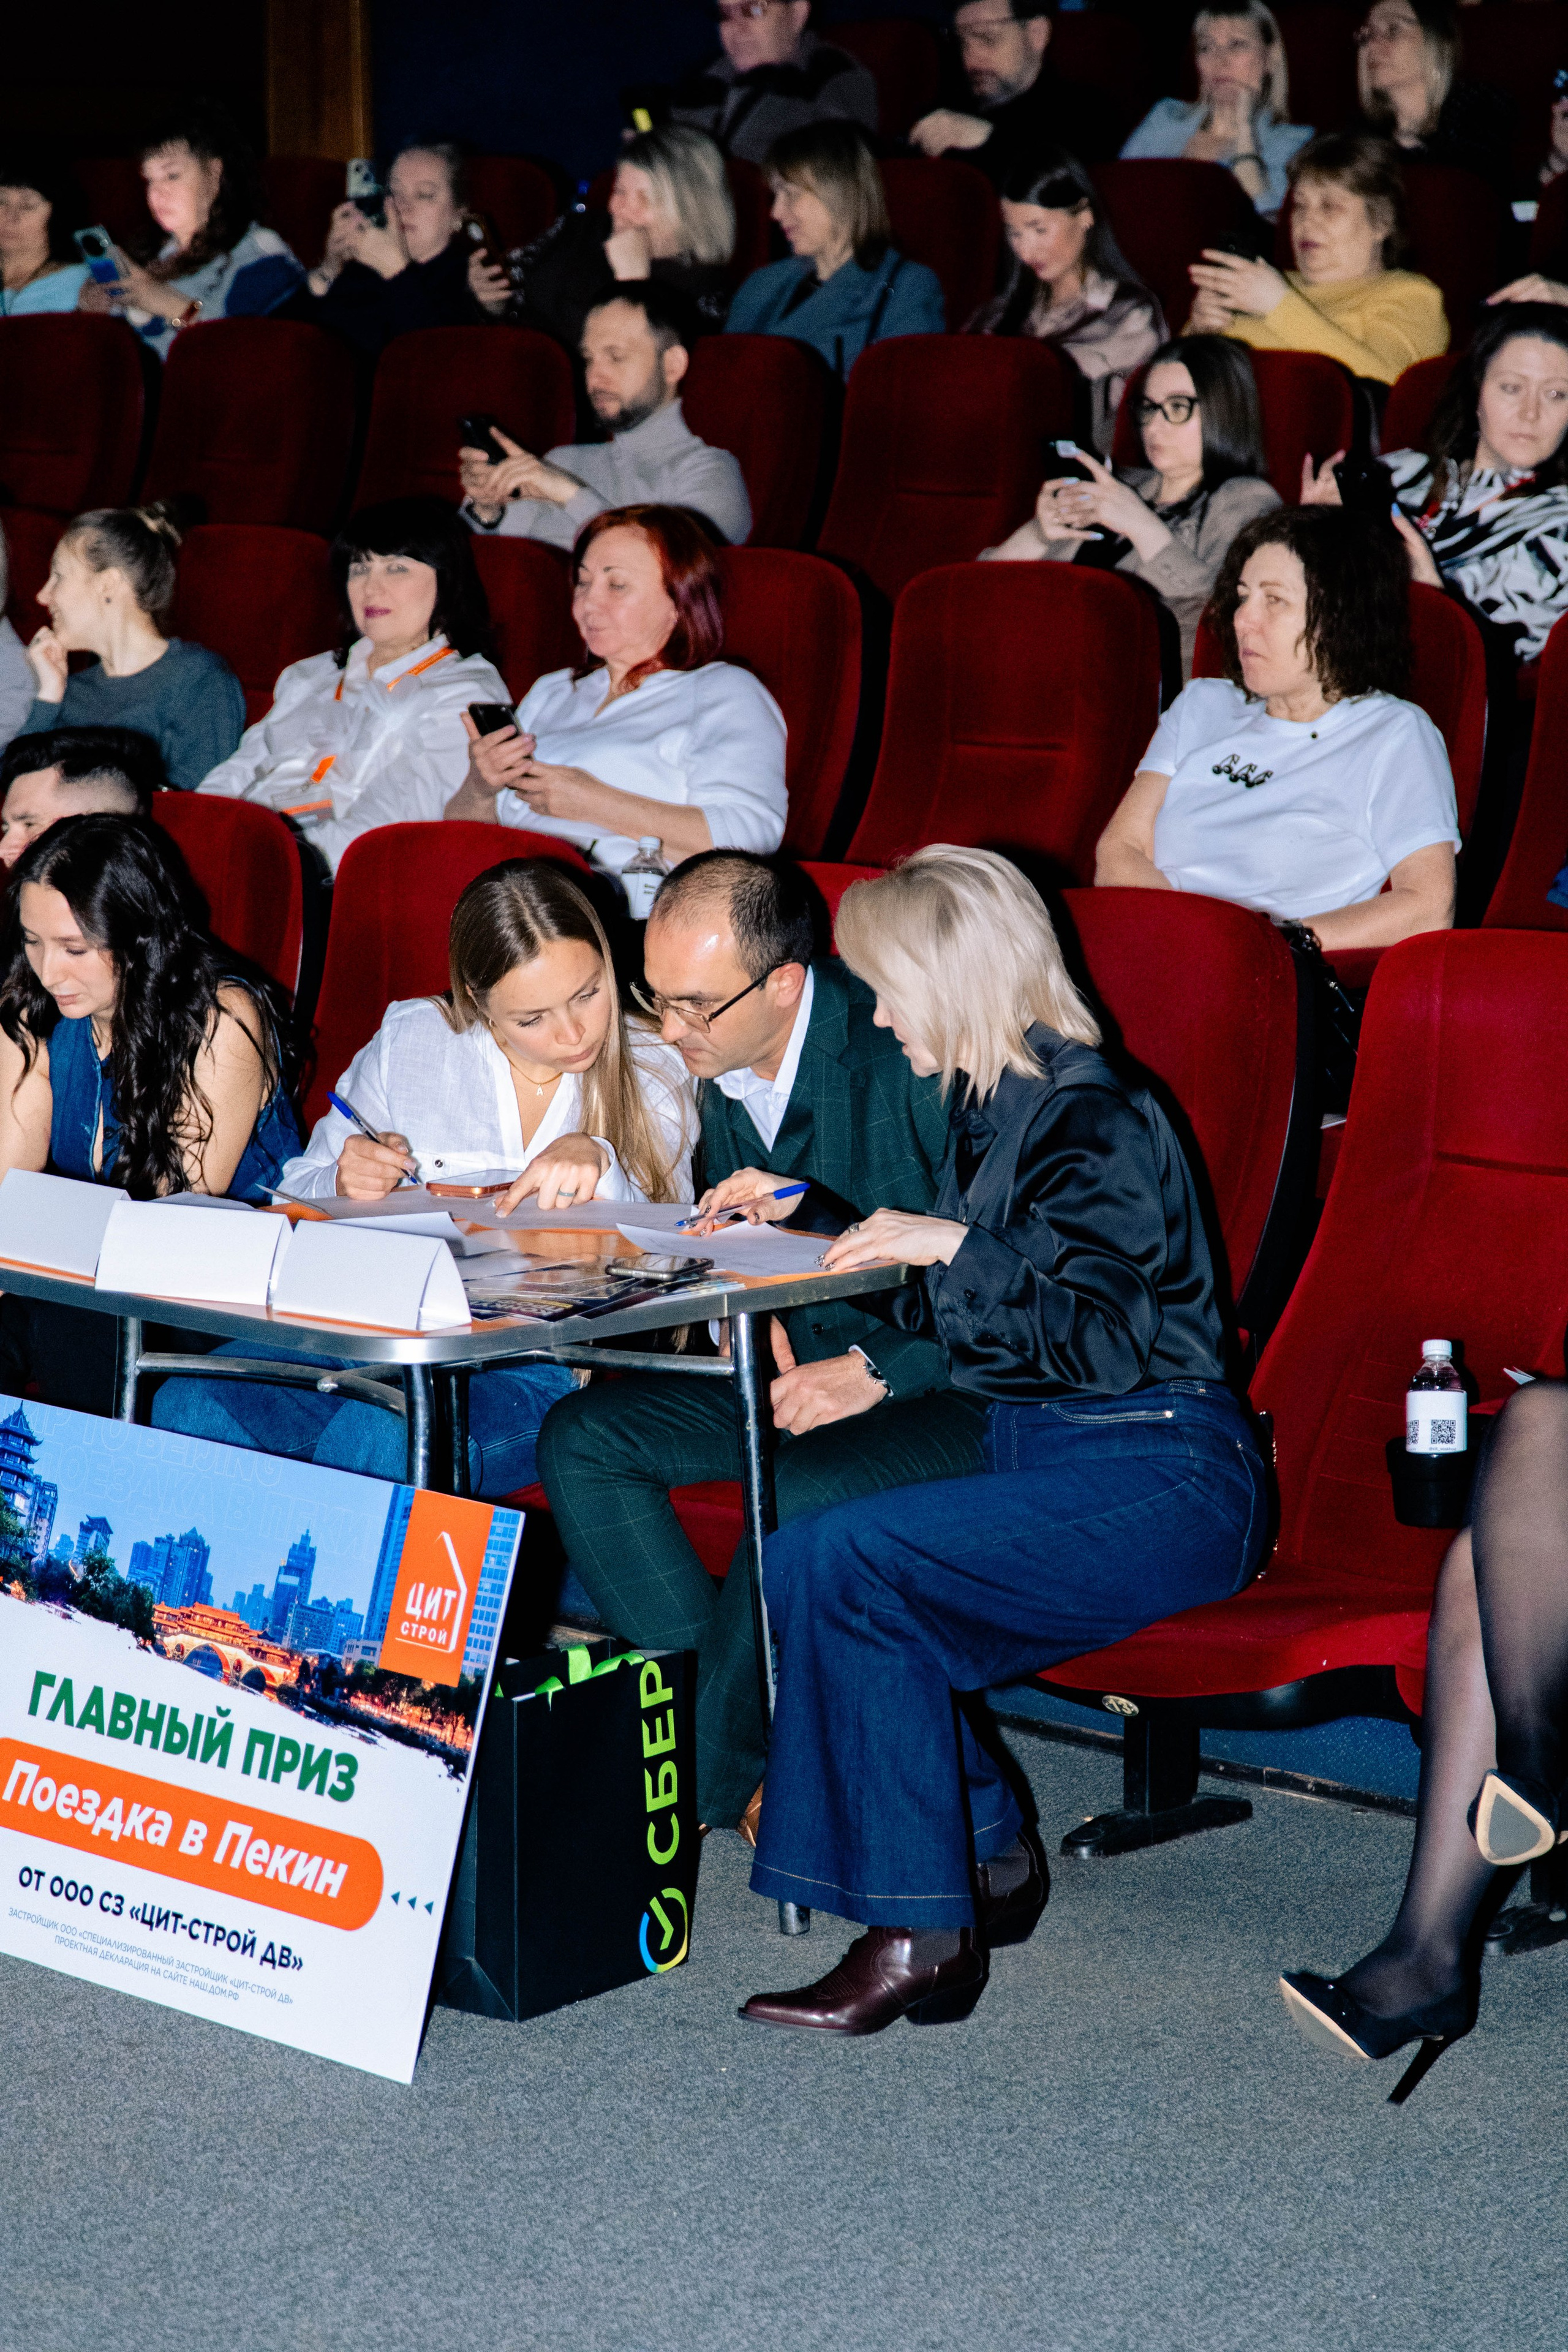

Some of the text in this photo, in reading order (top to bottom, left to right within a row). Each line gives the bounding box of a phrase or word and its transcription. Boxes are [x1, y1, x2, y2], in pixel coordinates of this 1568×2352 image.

[400, 1621, 448, 1645] СТРОЙ
[405, 1582, 458, 1622] ЦИТ
[28, 1670, 359, 1802] ГЛАВНЫЙ ПРИЗ
[640, 1660, 679, 1865] СБЕР
[2, 1758, 349, 1898] Поездка в Пекин
[8, 1907, 293, 2005] ЗАСТРОЙЩИК ООО «СПЕЦИАЛИЗИРОВАННЫЙ ЗАСТРОЙЩИК «ЦИТ-СТРОЙ ДВ»
[18, 1866, 304, 1972] ОТ ООО СЗ «ЦИТ-СТРОЙ ДВ»
[55, 1934, 239, 2001] ПРОЕКТНАЯ ДЕКЛАРАЦИЯ НА САЙТЕ НАШ.ДОМ.РФ
